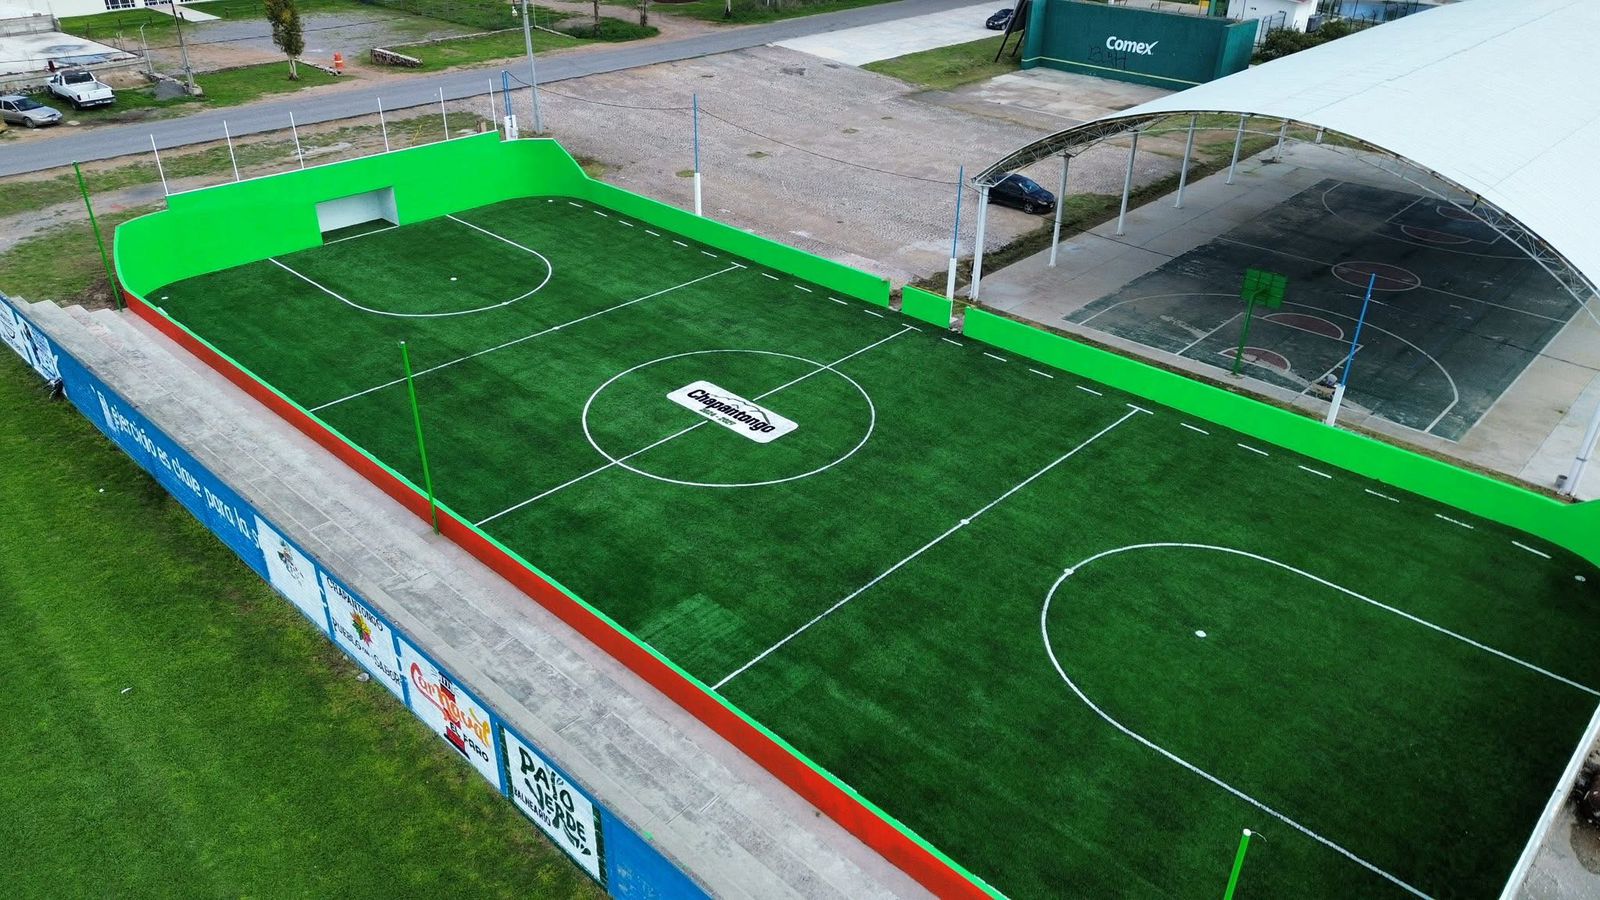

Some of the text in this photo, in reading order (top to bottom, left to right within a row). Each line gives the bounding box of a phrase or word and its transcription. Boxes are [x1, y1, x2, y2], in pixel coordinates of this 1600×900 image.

[1106, 35, 1159, 55] Comex
[687, 389, 776, 433] Chapantongo
[157, 446, 171, 470] es
[172, 457, 202, 497] clave
[204, 486, 235, 528] para
[326, 577, 384, 632] CHAPANTONGO
[410, 662, 490, 748] Carnaval
[449, 721, 489, 762] EL FARO
[524, 777, 587, 843] VERDE
